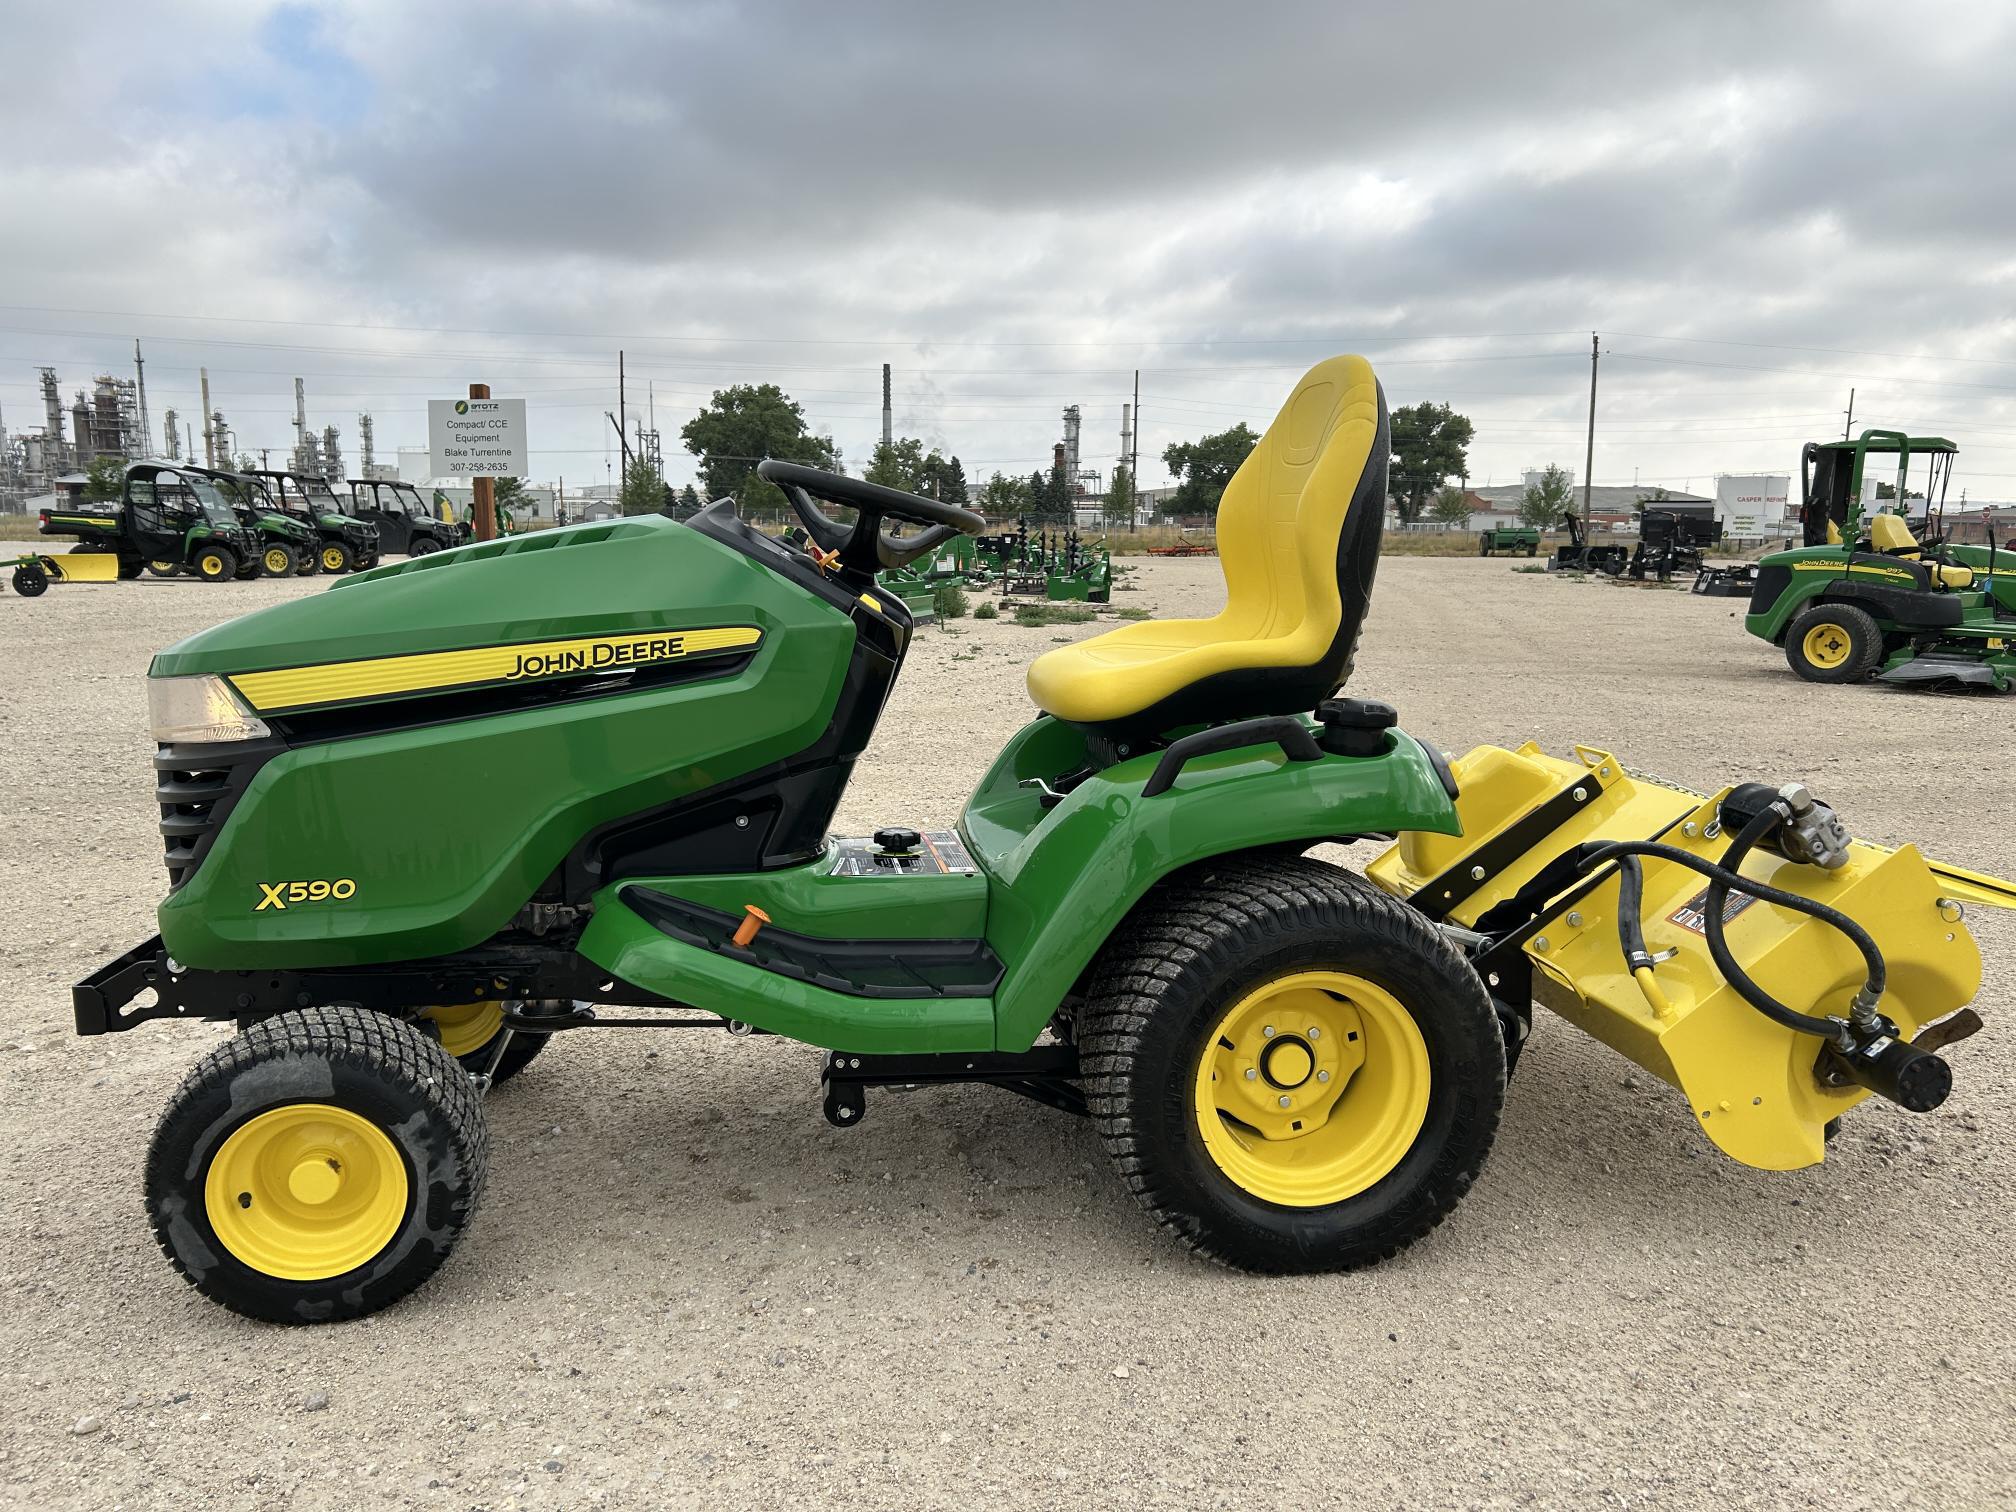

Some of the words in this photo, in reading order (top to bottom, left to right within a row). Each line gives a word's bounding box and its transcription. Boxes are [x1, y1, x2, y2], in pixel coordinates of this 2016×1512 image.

[488, 419, 508, 428] CCE
[455, 433, 500, 443] Equipment
[444, 448, 467, 457] Blake
[470, 448, 512, 456] Turrentine
[450, 463, 508, 471] 307-258-2635
[1800, 559, 1820, 567] JOHN
[1819, 559, 1845, 568] DEERE
[506, 650, 585, 678] JOHN
[592, 637, 685, 666] DEERE
[253, 878, 357, 911] X590
